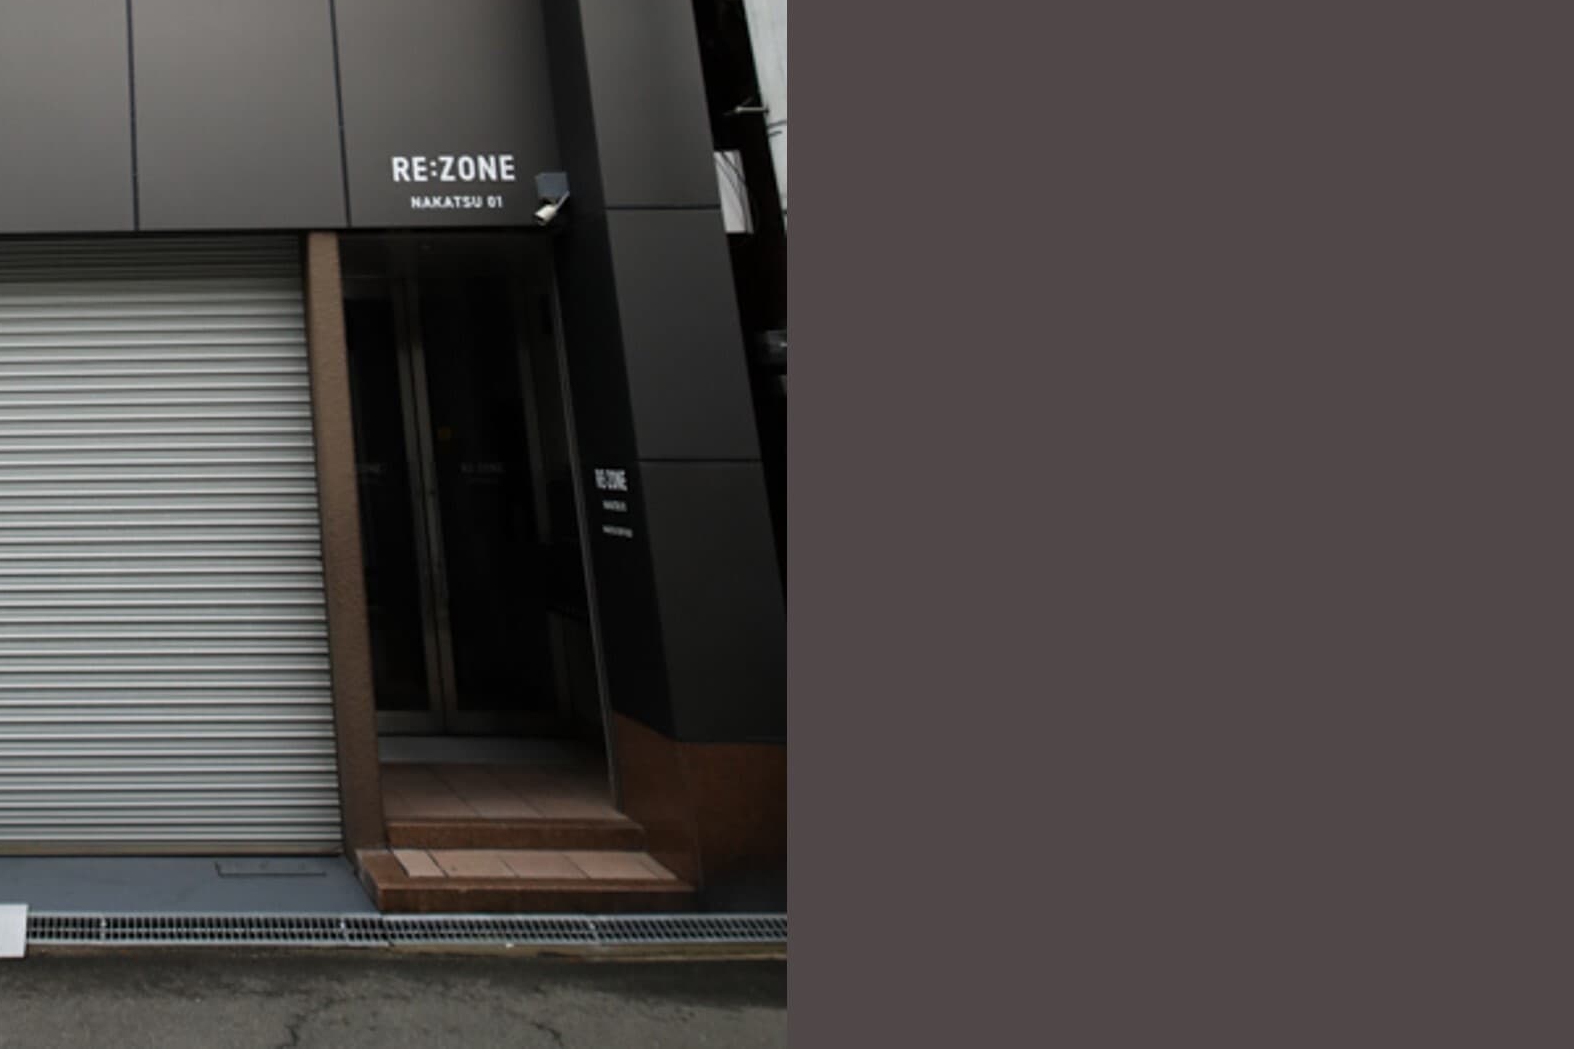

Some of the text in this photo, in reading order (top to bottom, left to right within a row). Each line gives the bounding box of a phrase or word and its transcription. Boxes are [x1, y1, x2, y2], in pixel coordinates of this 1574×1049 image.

[391, 154, 516, 183] RE:ZONE
[411, 195, 503, 209] NAKATSU 01
